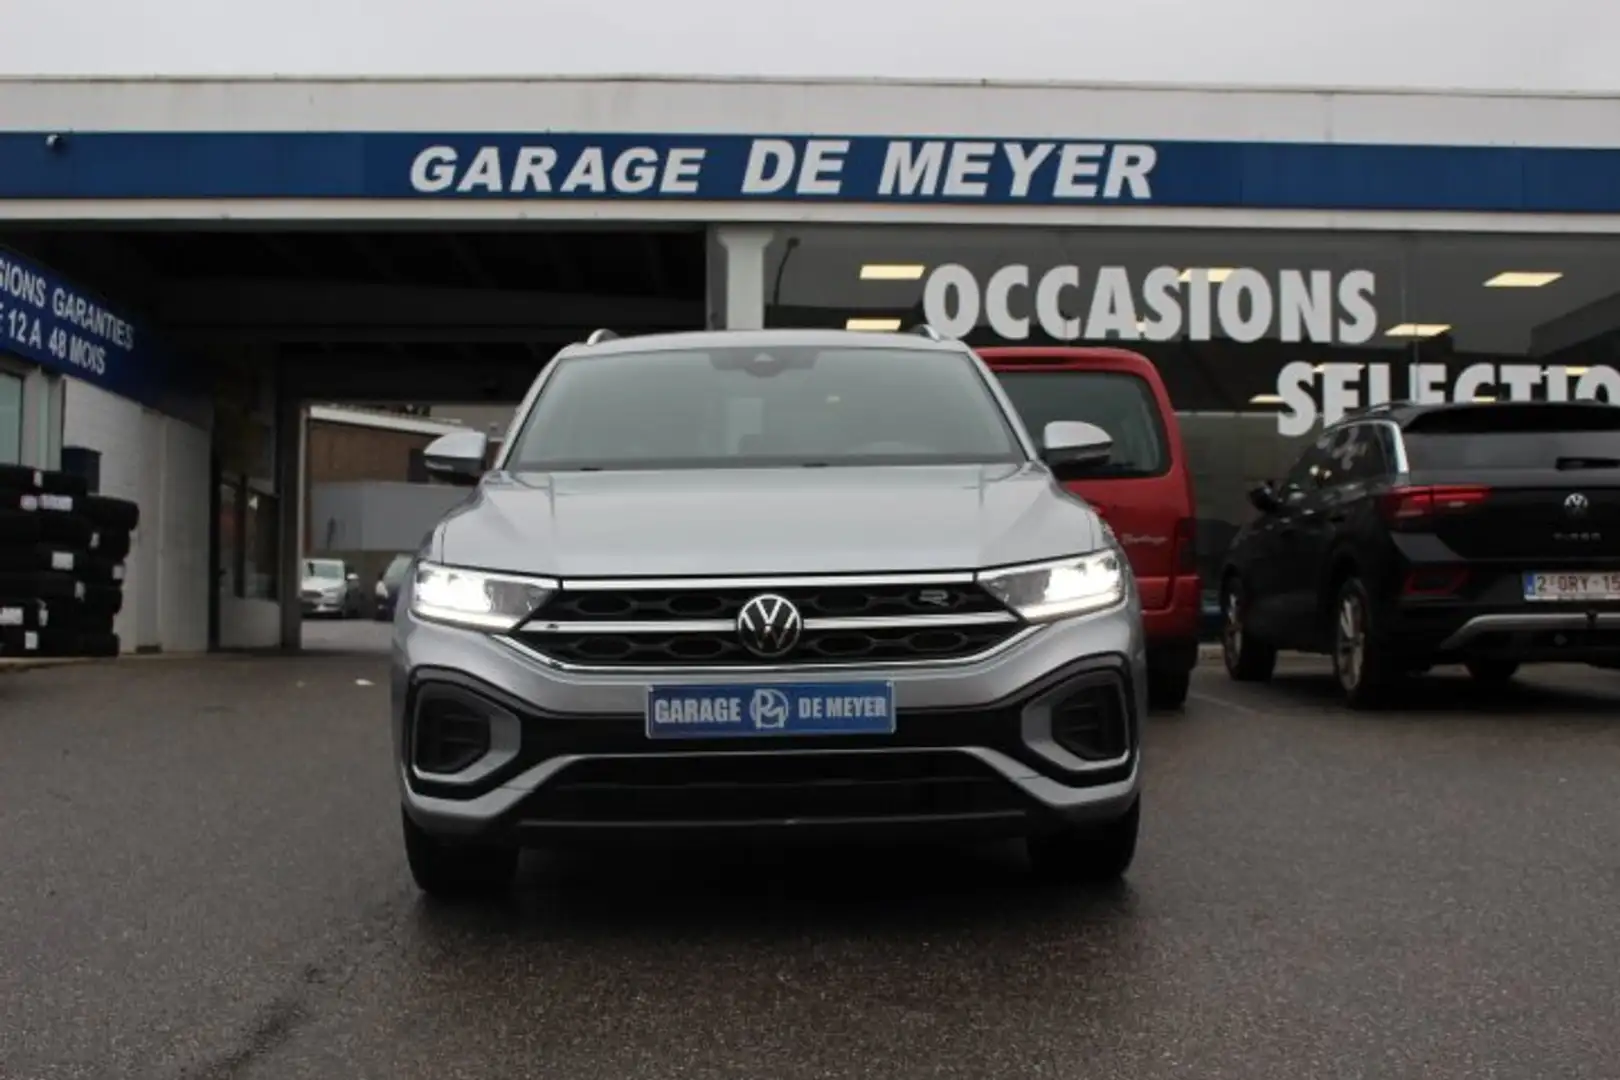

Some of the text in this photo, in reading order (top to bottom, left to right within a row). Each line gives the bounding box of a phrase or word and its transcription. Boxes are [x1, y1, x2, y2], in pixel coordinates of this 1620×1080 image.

[410, 139, 1157, 199] GARAGE DE MEYER
[52, 287, 134, 352] GARANTIES
[923, 264, 1378, 344] OCCASIONS
[8, 308, 27, 344] 12
[28, 318, 42, 350] A
[48, 325, 67, 360] 48
[69, 333, 106, 376] MOIS
[654, 698, 741, 724] GARAGE
[799, 697, 822, 719] DE
[826, 696, 887, 718] MEYER
